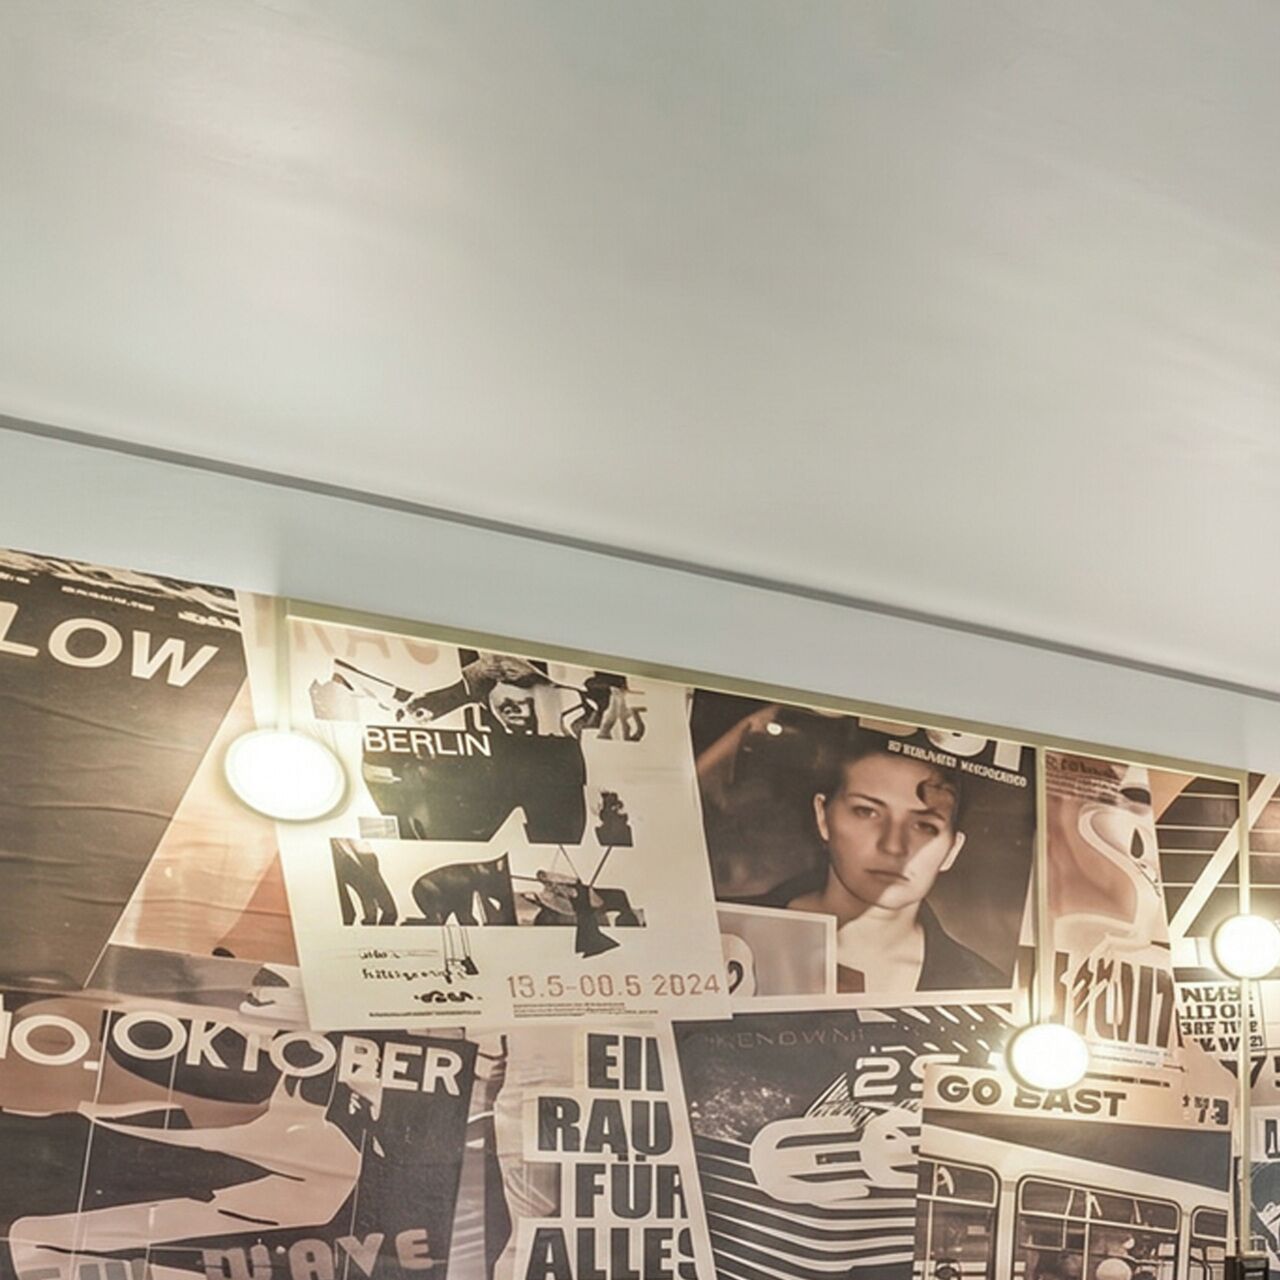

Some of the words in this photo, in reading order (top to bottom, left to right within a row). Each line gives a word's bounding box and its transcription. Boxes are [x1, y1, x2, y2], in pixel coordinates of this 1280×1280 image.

[364, 729, 491, 757] BERLIN
[652, 973, 720, 996] 2024
[111, 1010, 464, 1096] OKTOBER
[937, 1074, 1001, 1106] GO
